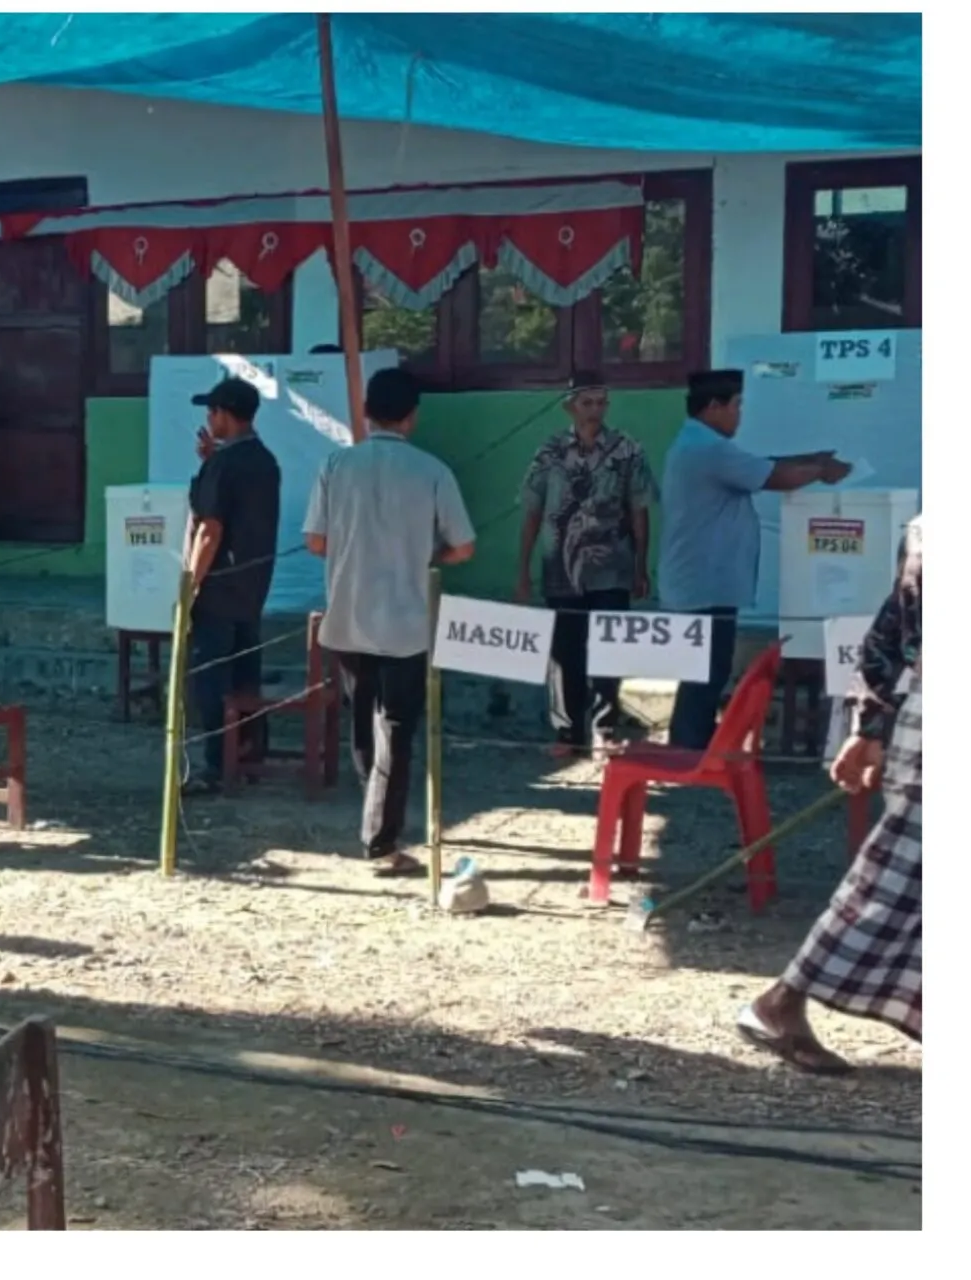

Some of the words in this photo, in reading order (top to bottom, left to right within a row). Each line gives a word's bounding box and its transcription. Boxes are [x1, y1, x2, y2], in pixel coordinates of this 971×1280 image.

[819, 338, 871, 360] TPS
[877, 337, 892, 358] 4
[813, 537, 838, 553] TPS
[841, 539, 859, 553] 04
[445, 620, 542, 654] MASUK
[595, 613, 672, 646] TPS
[682, 618, 705, 647] 4
